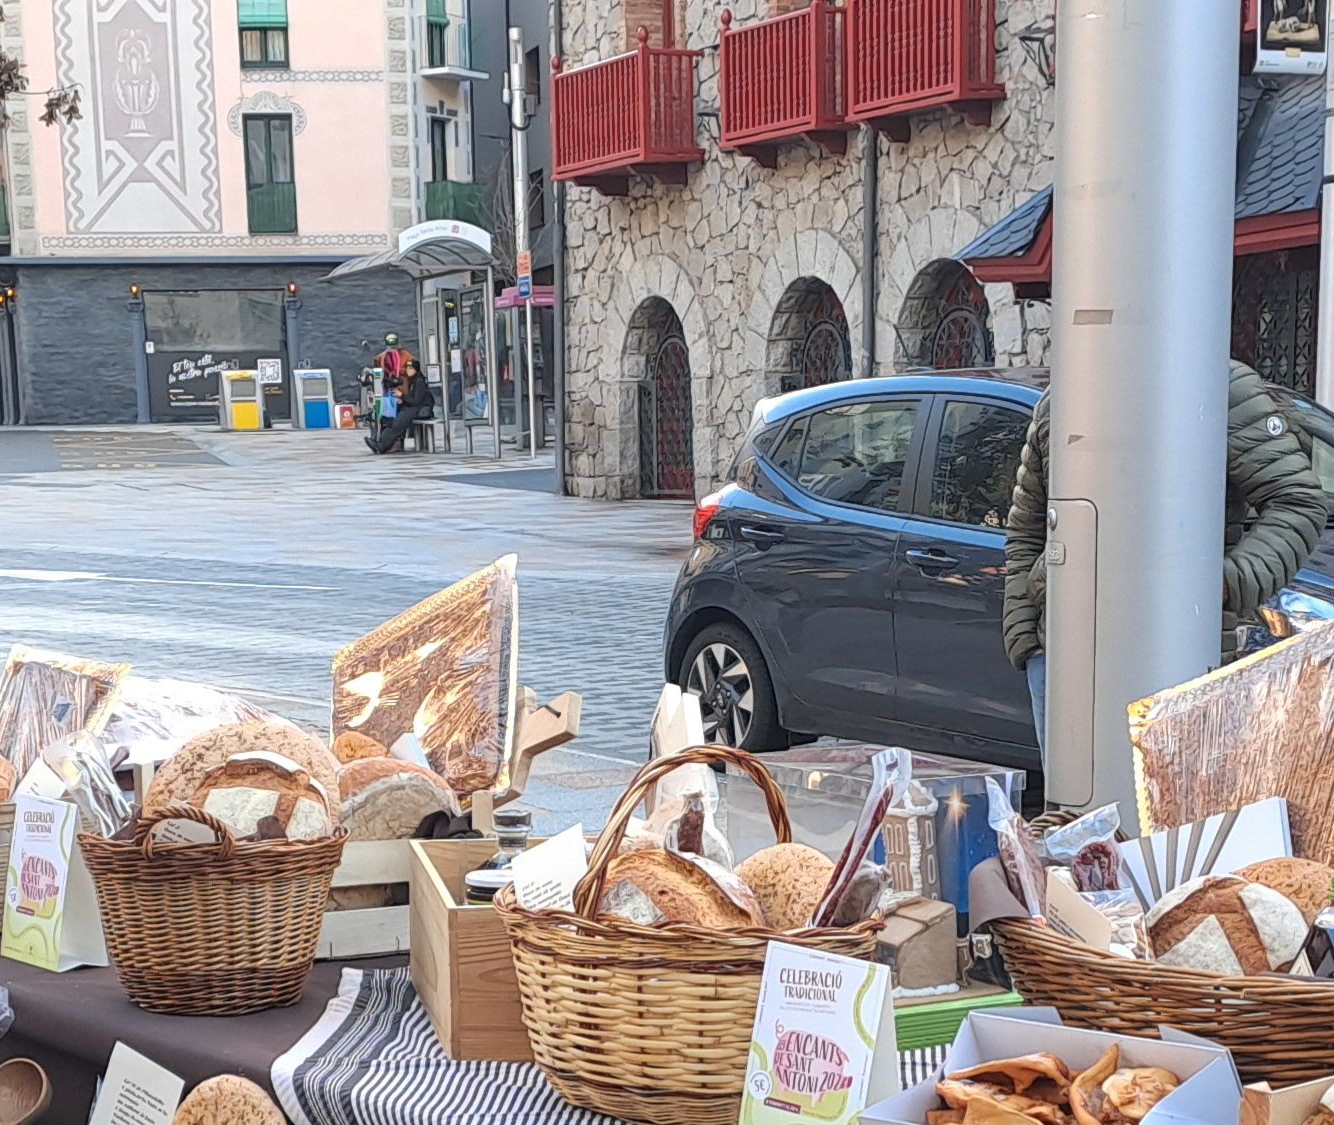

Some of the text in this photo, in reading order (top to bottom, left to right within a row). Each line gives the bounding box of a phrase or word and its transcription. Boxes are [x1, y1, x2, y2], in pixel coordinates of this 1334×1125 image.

[779, 967, 842, 990] CELEBRACIÓ
[784, 985, 837, 1002] TRADICIONAL
[785, 1031, 843, 1066] ENCANTS
[785, 1053, 814, 1074] SANT
[754, 1079, 766, 1092] 5€
[776, 1065, 818, 1094] ANTONI
